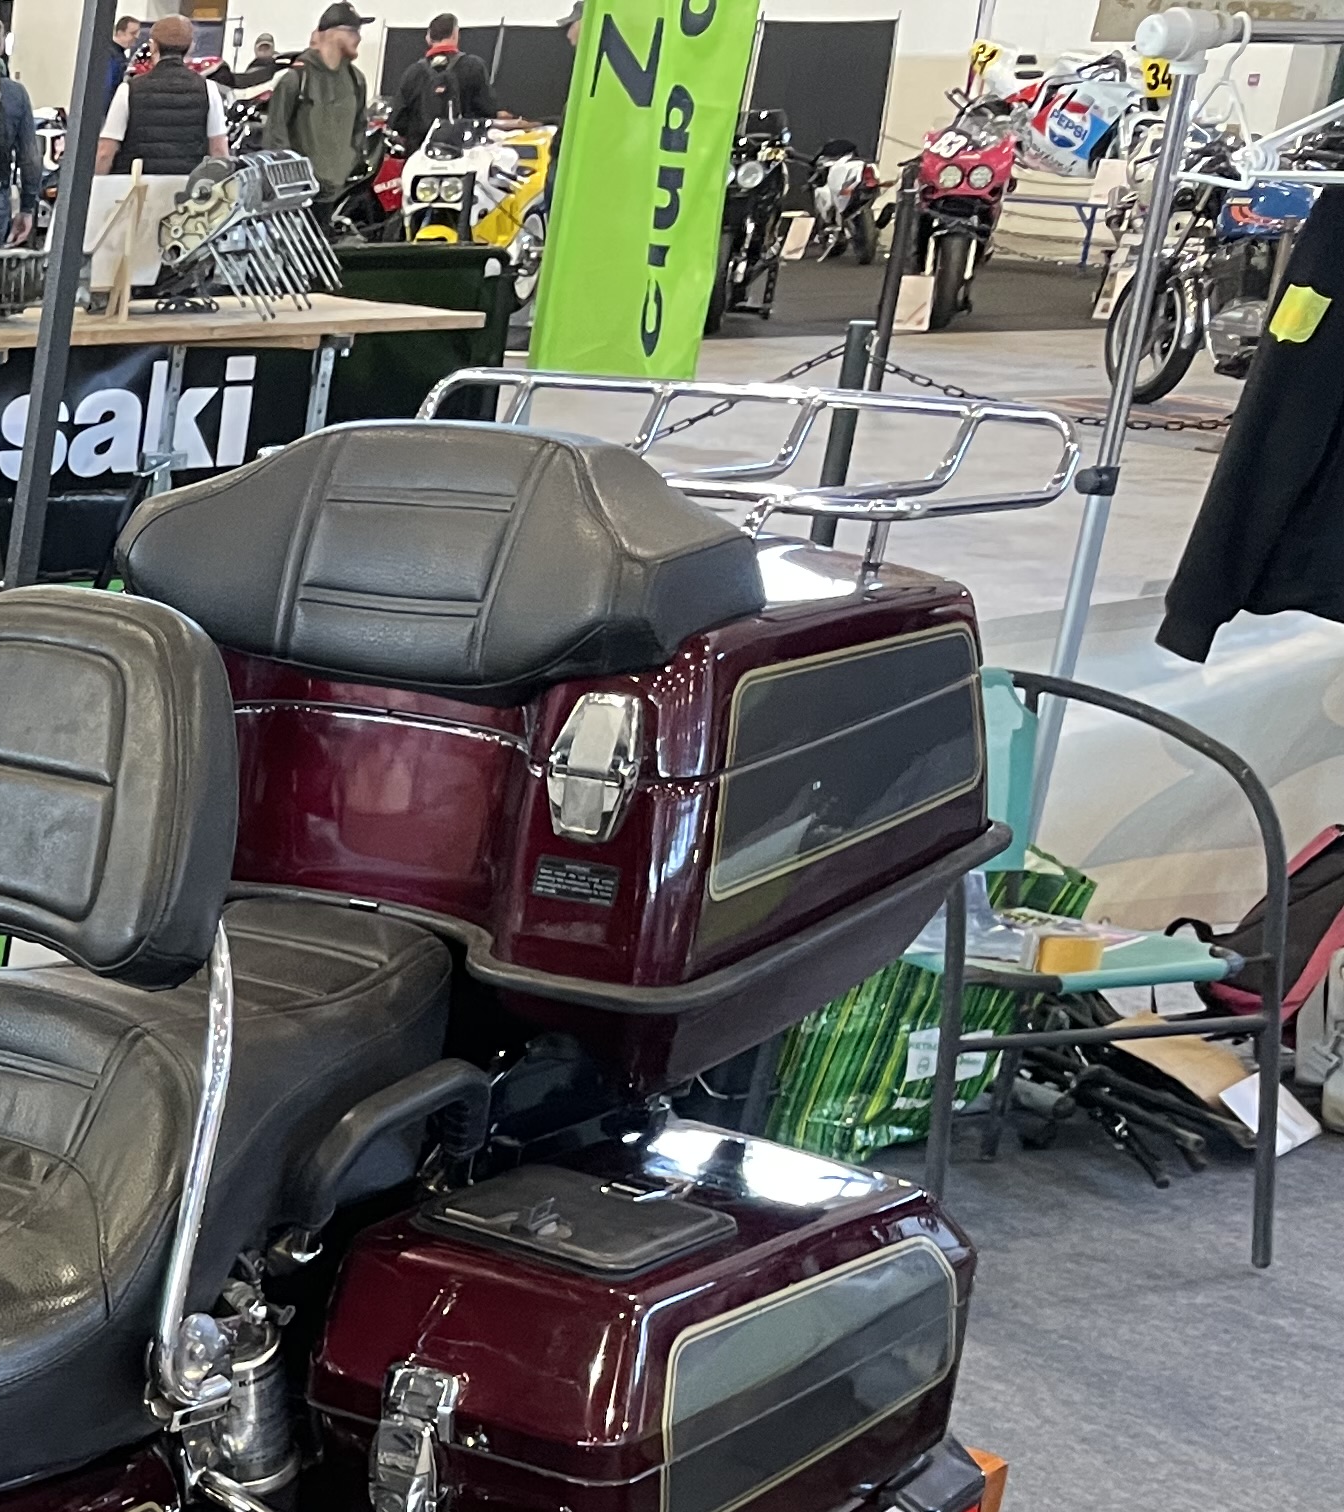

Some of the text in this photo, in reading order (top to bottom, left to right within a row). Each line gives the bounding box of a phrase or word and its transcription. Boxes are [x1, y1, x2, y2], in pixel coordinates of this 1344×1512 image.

[1146, 63, 1172, 91] 34
[1049, 108, 1089, 141] PEPSI
[929, 131, 968, 158] 83
